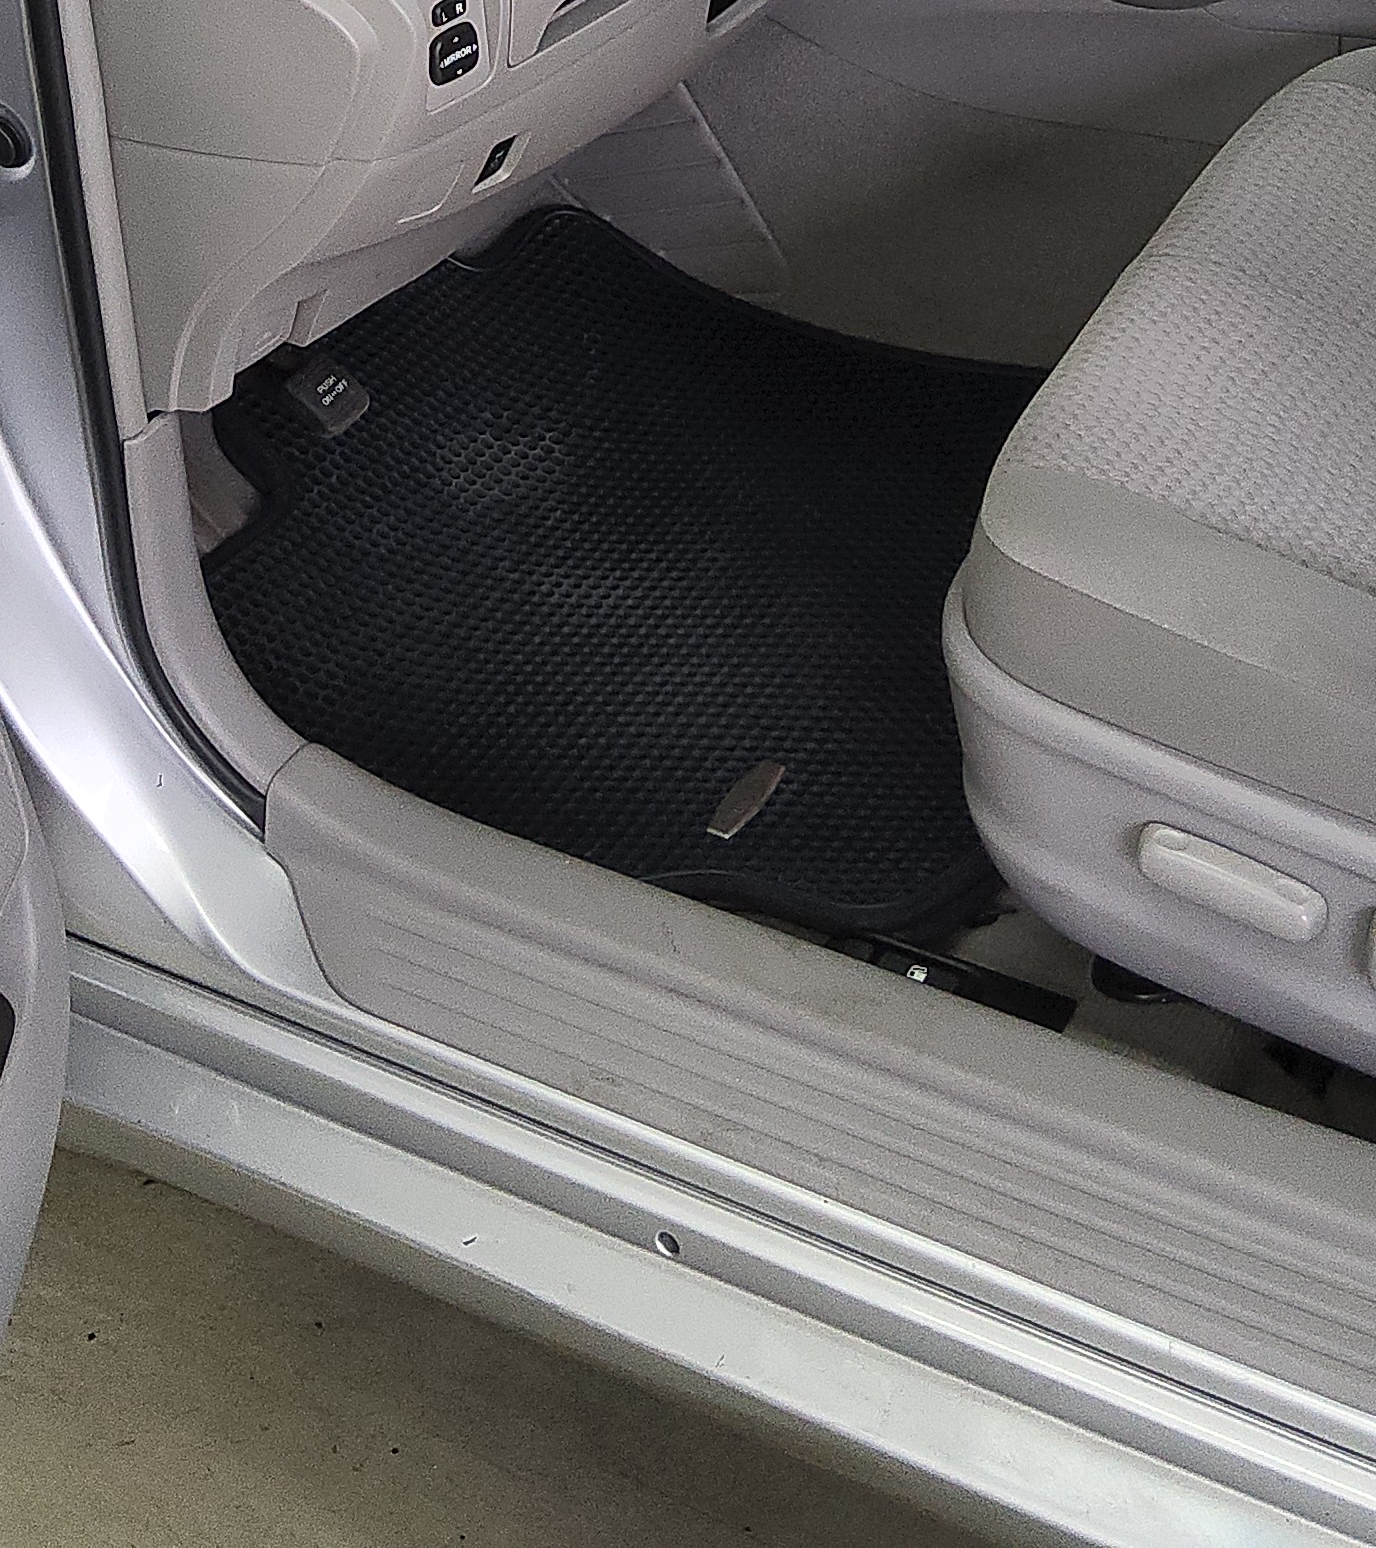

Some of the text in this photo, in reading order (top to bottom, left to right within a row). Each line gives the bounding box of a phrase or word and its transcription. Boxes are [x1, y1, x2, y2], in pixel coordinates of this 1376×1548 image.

[455, 0, 464, 15] R
[443, 45, 473, 68] MIRROR
[316, 373, 338, 394] PUSH
